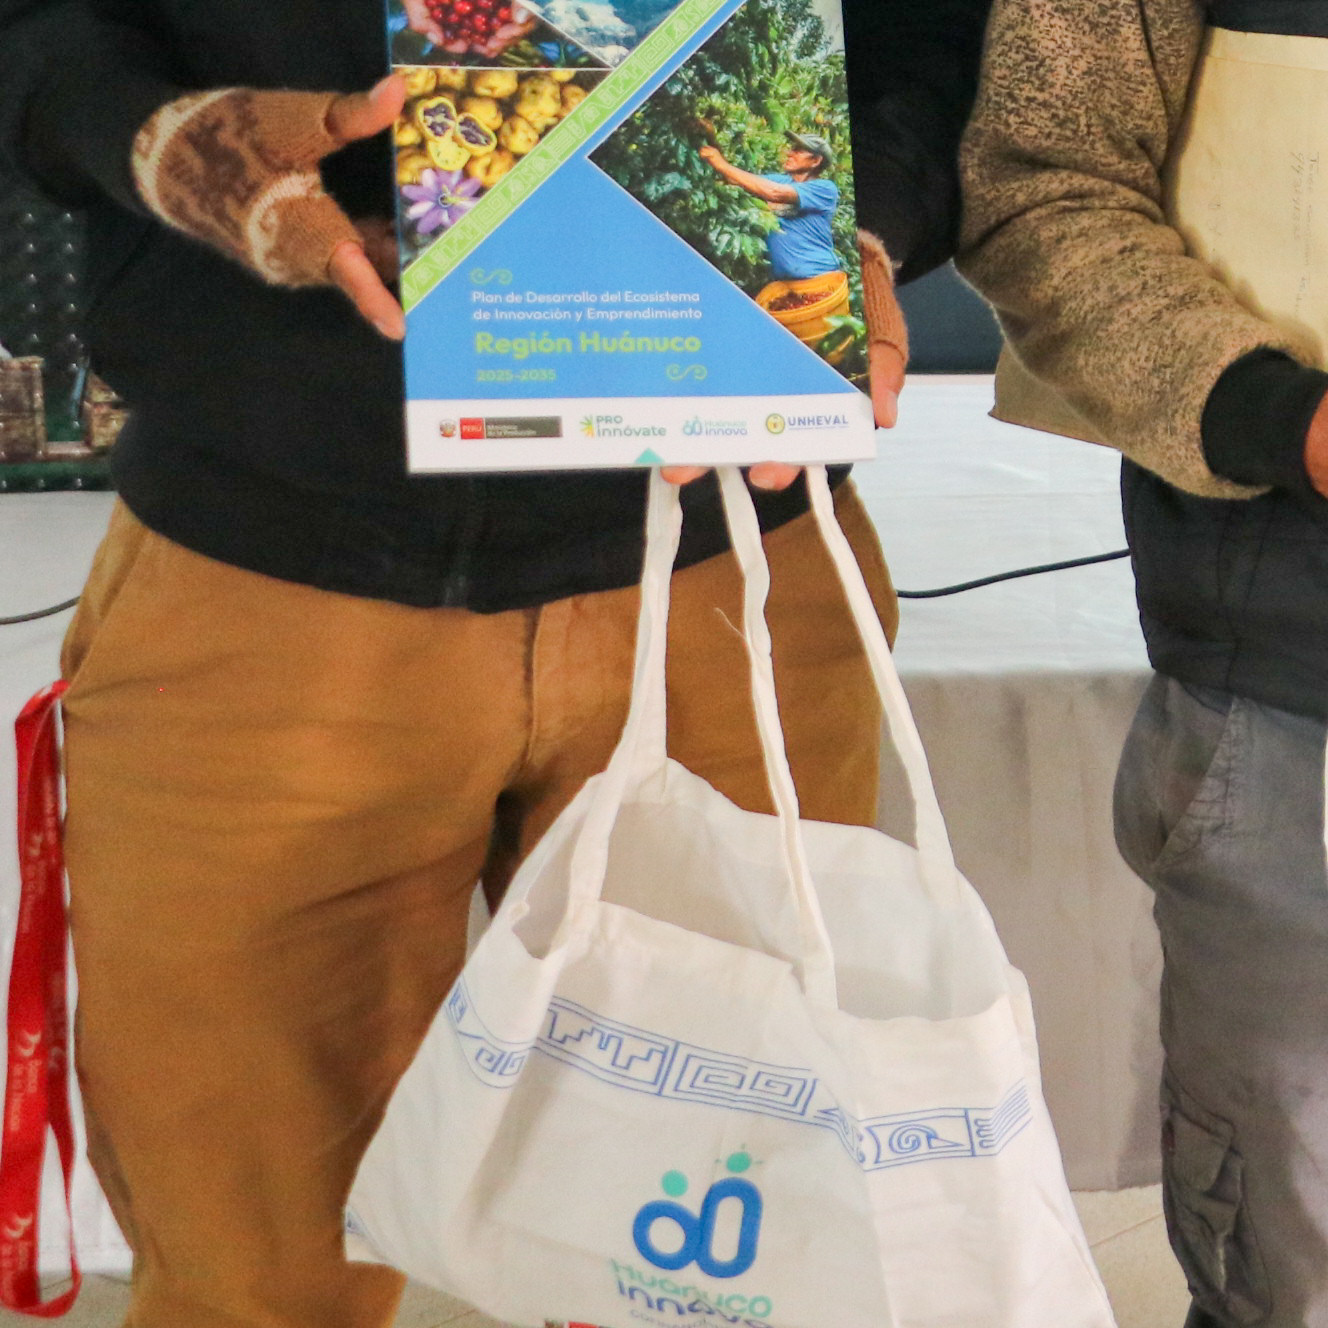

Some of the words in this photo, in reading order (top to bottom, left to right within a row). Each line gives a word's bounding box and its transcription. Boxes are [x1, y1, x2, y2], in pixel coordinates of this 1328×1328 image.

[472, 292, 503, 303] Plan
[506, 292, 522, 303] de
[527, 291, 597, 303] Desarrollo
[601, 291, 621, 302] del
[625, 291, 699, 302] Ecosistema
[474, 309, 490, 320] de
[495, 309, 571, 320] Innovación
[576, 311, 582, 321] y
[587, 307, 702, 320] Emprendimiento
[475, 332, 572, 359] Región
[580, 331, 701, 352] Huánuco
[477, 369, 556, 381] 2025-2035
[596, 416, 623, 424] PRO
[788, 416, 849, 426] UNHEVAL
[597, 425, 666, 437] innóvate
[705, 427, 747, 435] innova
